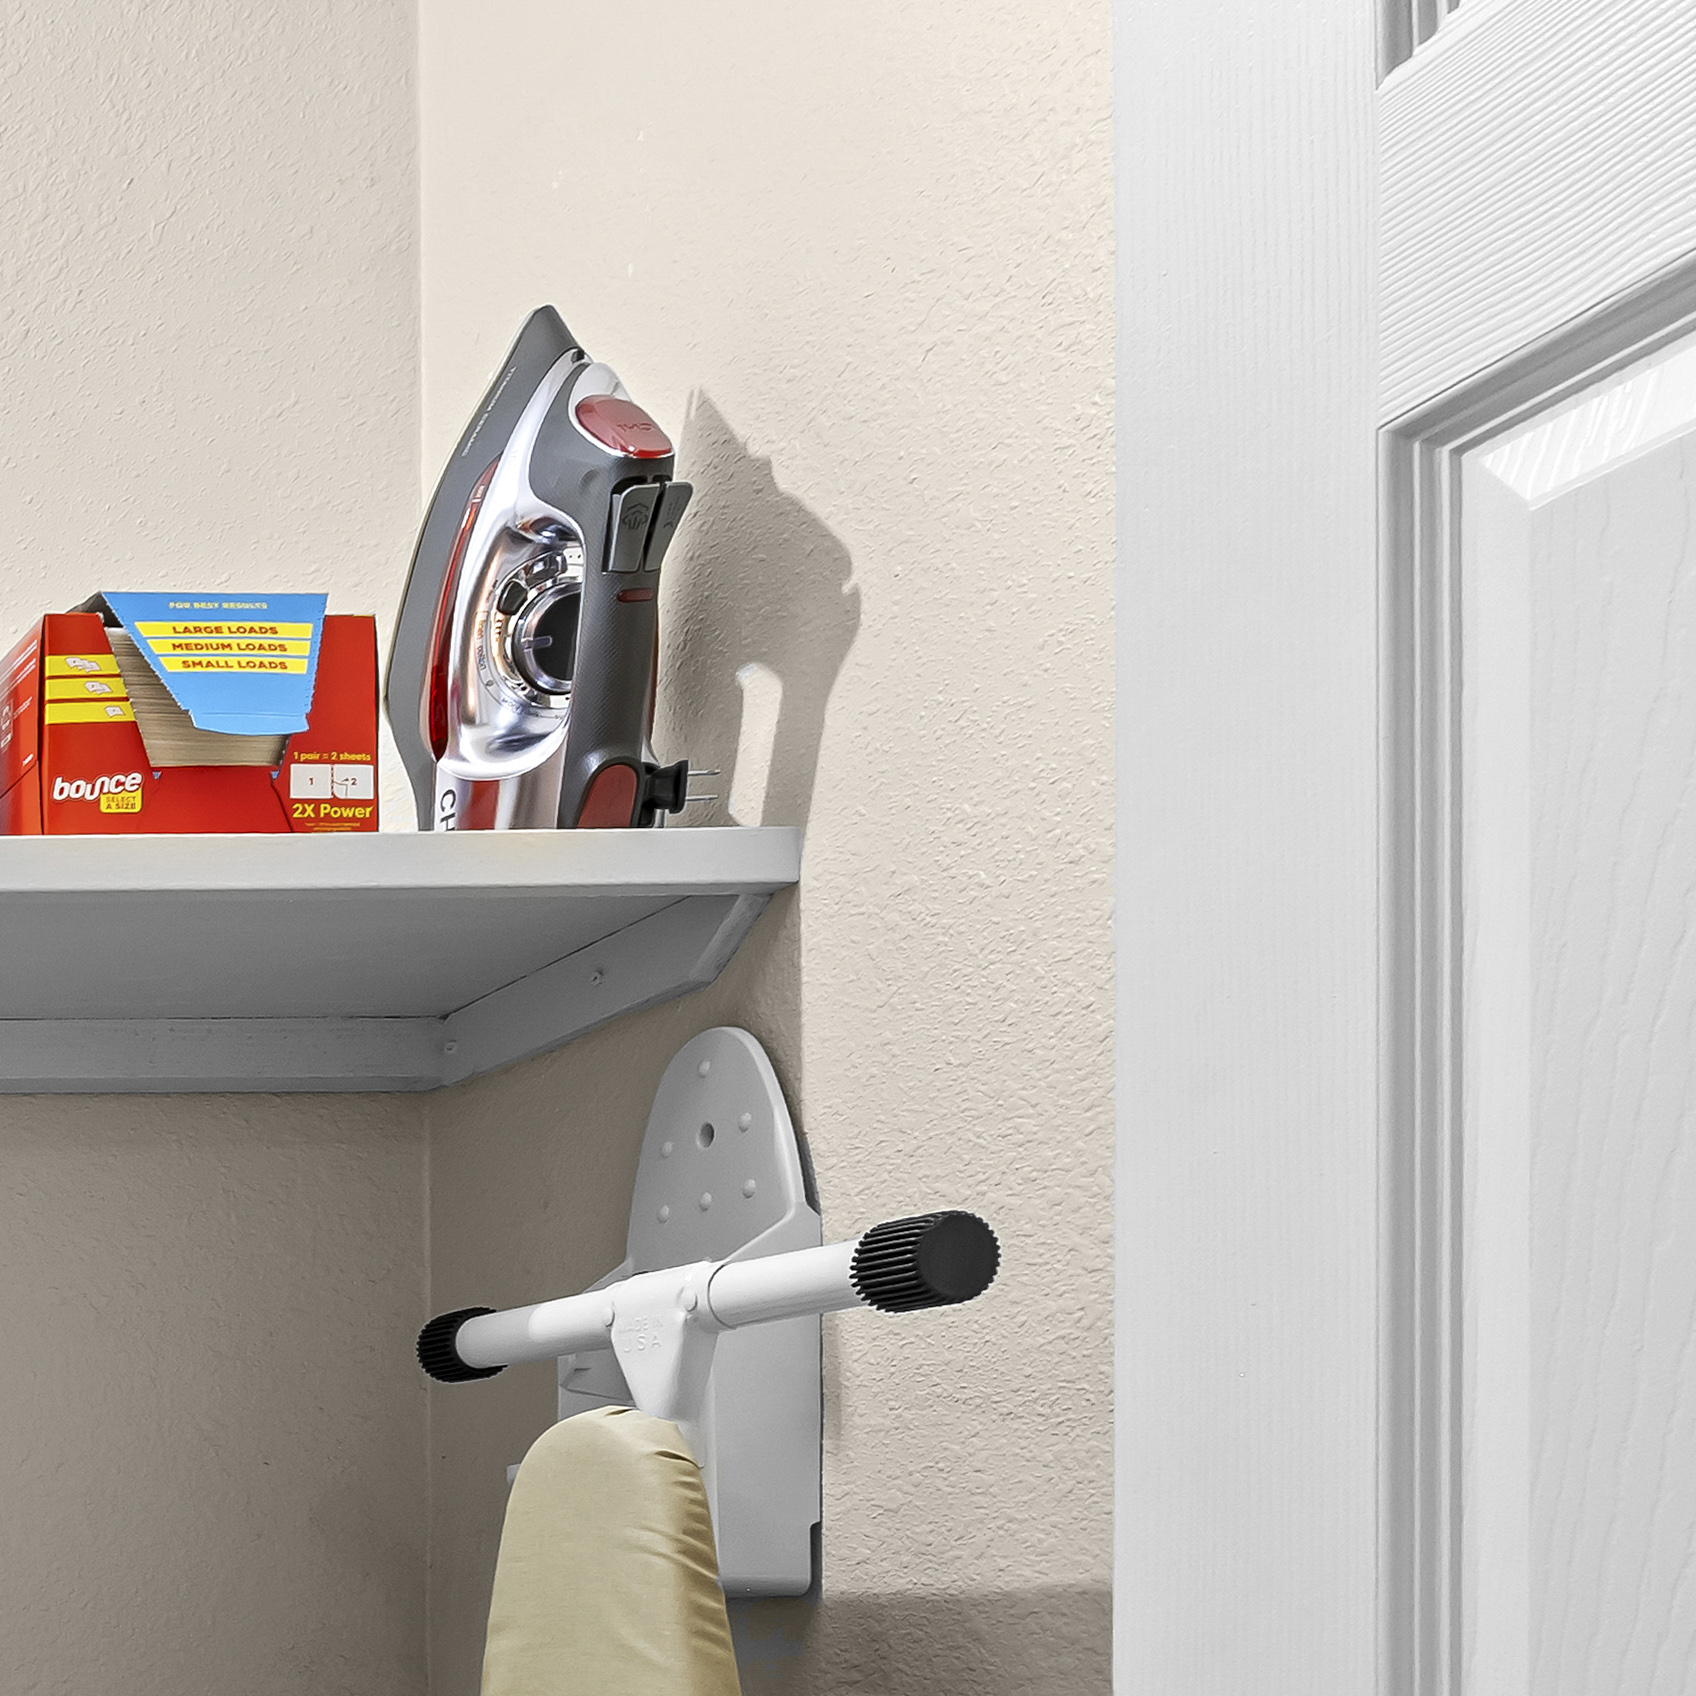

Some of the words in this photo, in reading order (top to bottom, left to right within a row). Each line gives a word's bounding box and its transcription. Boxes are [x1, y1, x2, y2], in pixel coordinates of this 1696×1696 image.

[172, 626, 224, 634] LARGE
[228, 626, 278, 635] LOADS
[172, 643, 233, 651] MEDIUM
[237, 643, 288, 652] LOADS
[182, 660, 234, 668] SMALL
[238, 660, 288, 670] LOADS
[293, 752, 298, 760] 1
[300, 752, 320, 761] pair
[330, 752, 337, 760] 2
[339, 752, 371, 761] sheets
[309, 777, 314, 785] 1
[53, 772, 142, 801] bounce
[292, 803, 315, 818] 2X
[319, 803, 374, 818] Power
